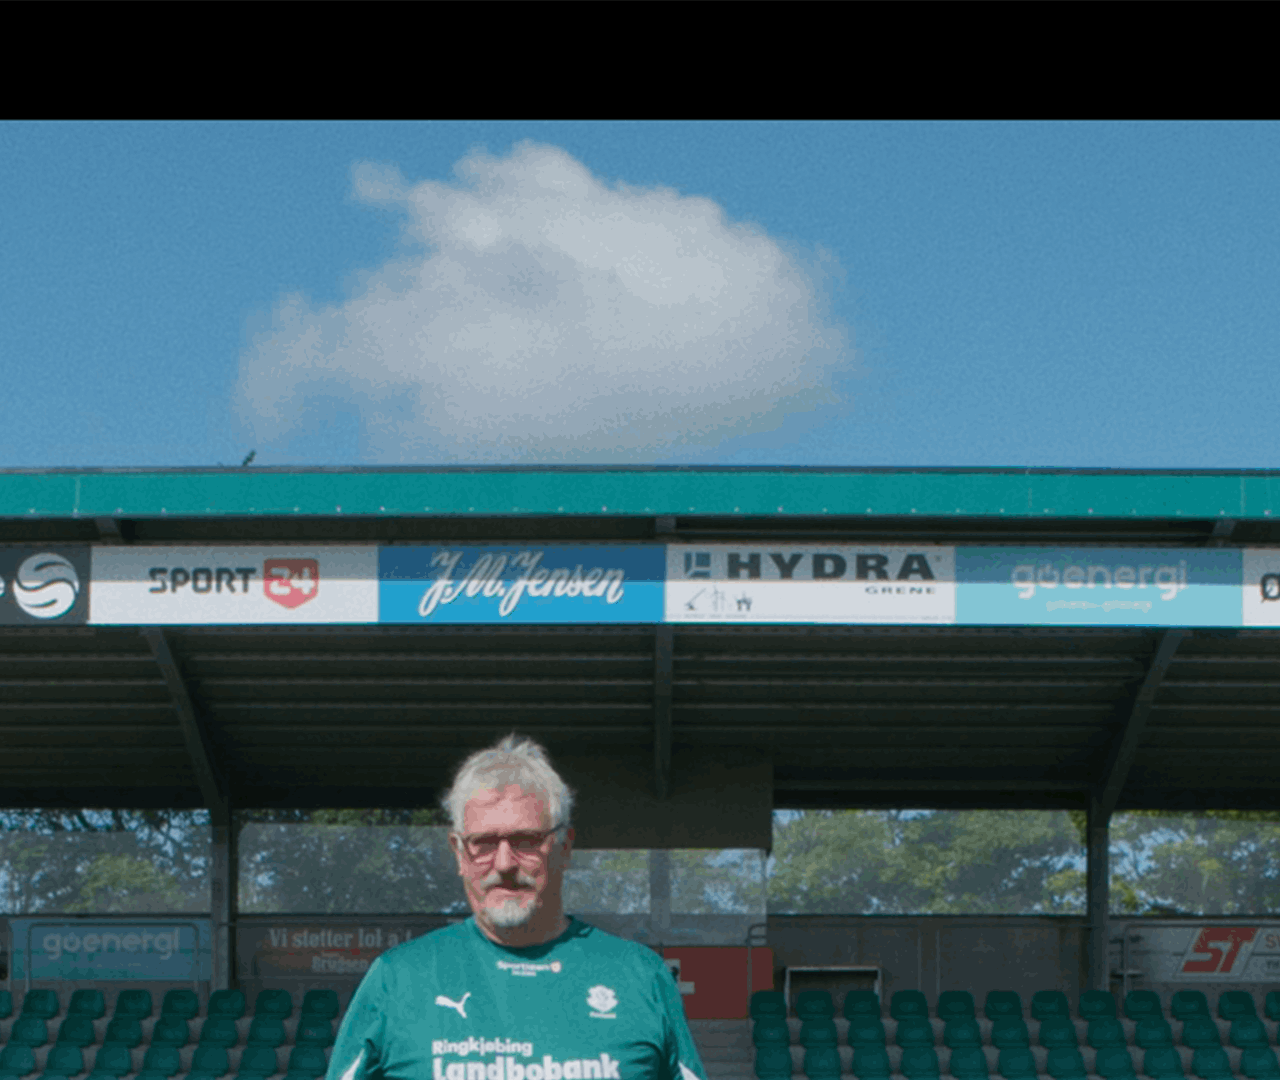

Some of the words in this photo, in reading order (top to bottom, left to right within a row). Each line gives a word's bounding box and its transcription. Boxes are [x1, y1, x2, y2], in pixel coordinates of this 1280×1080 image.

[727, 552, 935, 581] HYDRA
[148, 567, 257, 594] SPORT
[267, 565, 318, 597] 24
[864, 585, 937, 596] GRENE
[270, 928, 288, 948] Vi
[432, 1036, 533, 1057] Ringkjøbing
